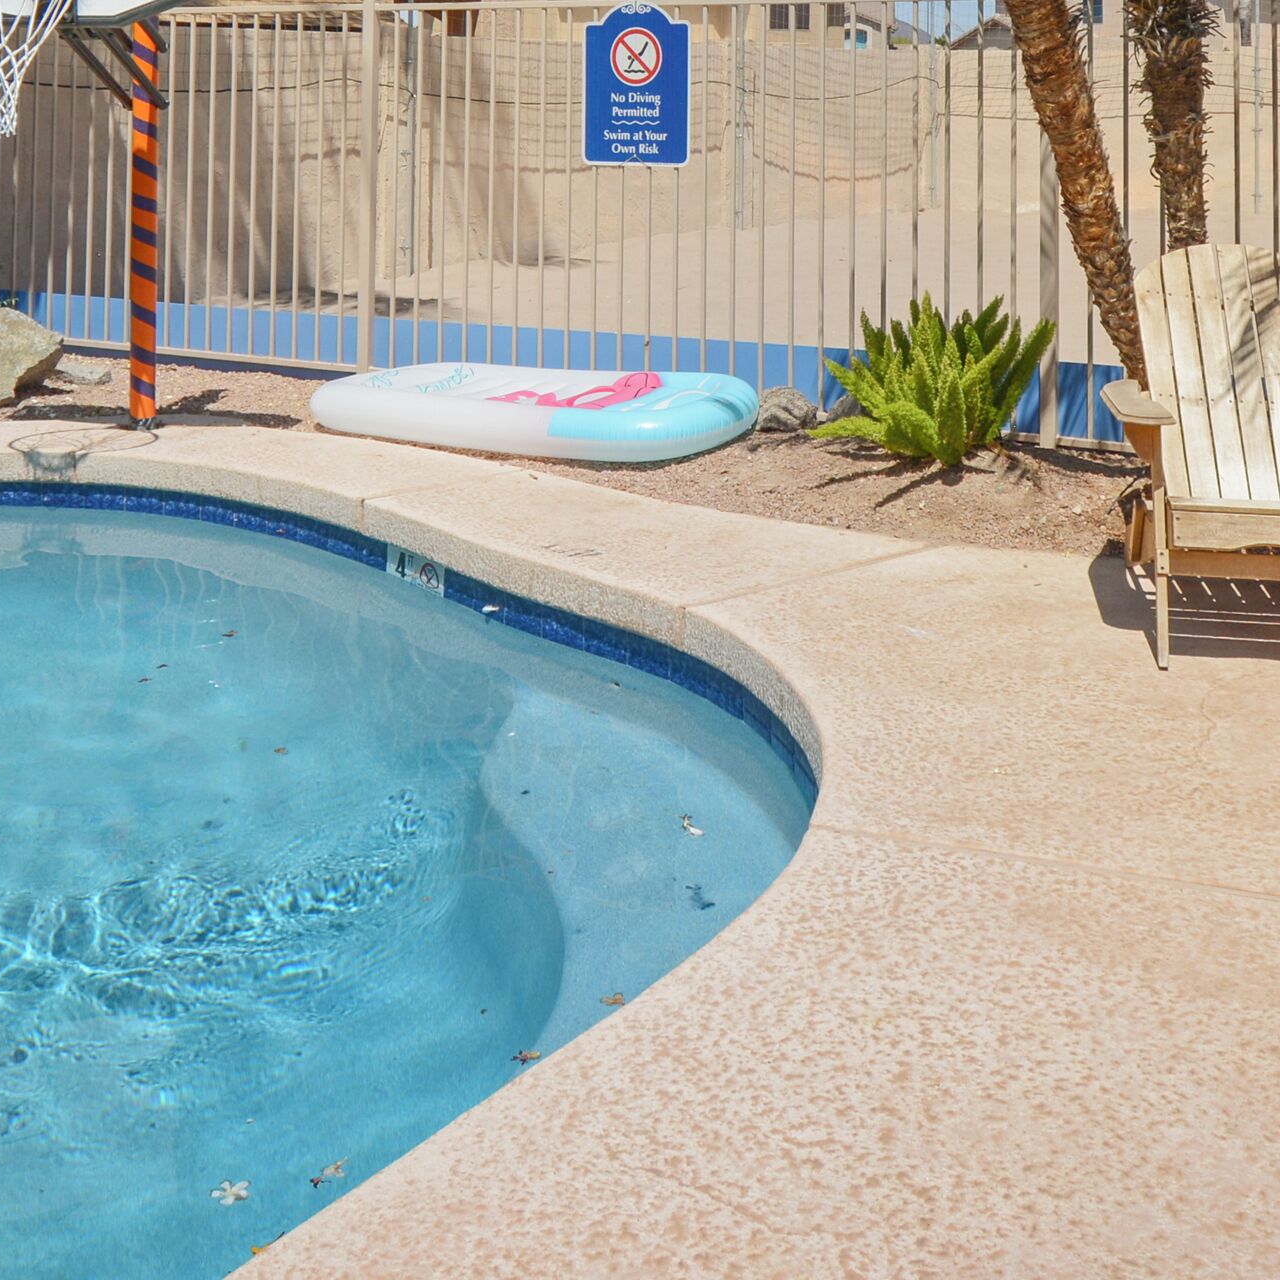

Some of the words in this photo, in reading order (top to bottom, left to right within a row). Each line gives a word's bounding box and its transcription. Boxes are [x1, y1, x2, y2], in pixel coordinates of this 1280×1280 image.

[610, 92, 626, 103] No
[628, 92, 661, 106] Diving
[612, 106, 660, 117] Permitted
[603, 129, 630, 140] Swim
[632, 131, 643, 140] at
[644, 130, 668, 141] Your
[611, 143, 636, 154] Own
[638, 143, 659, 154] Risk
[395, 552, 406, 578] 4
